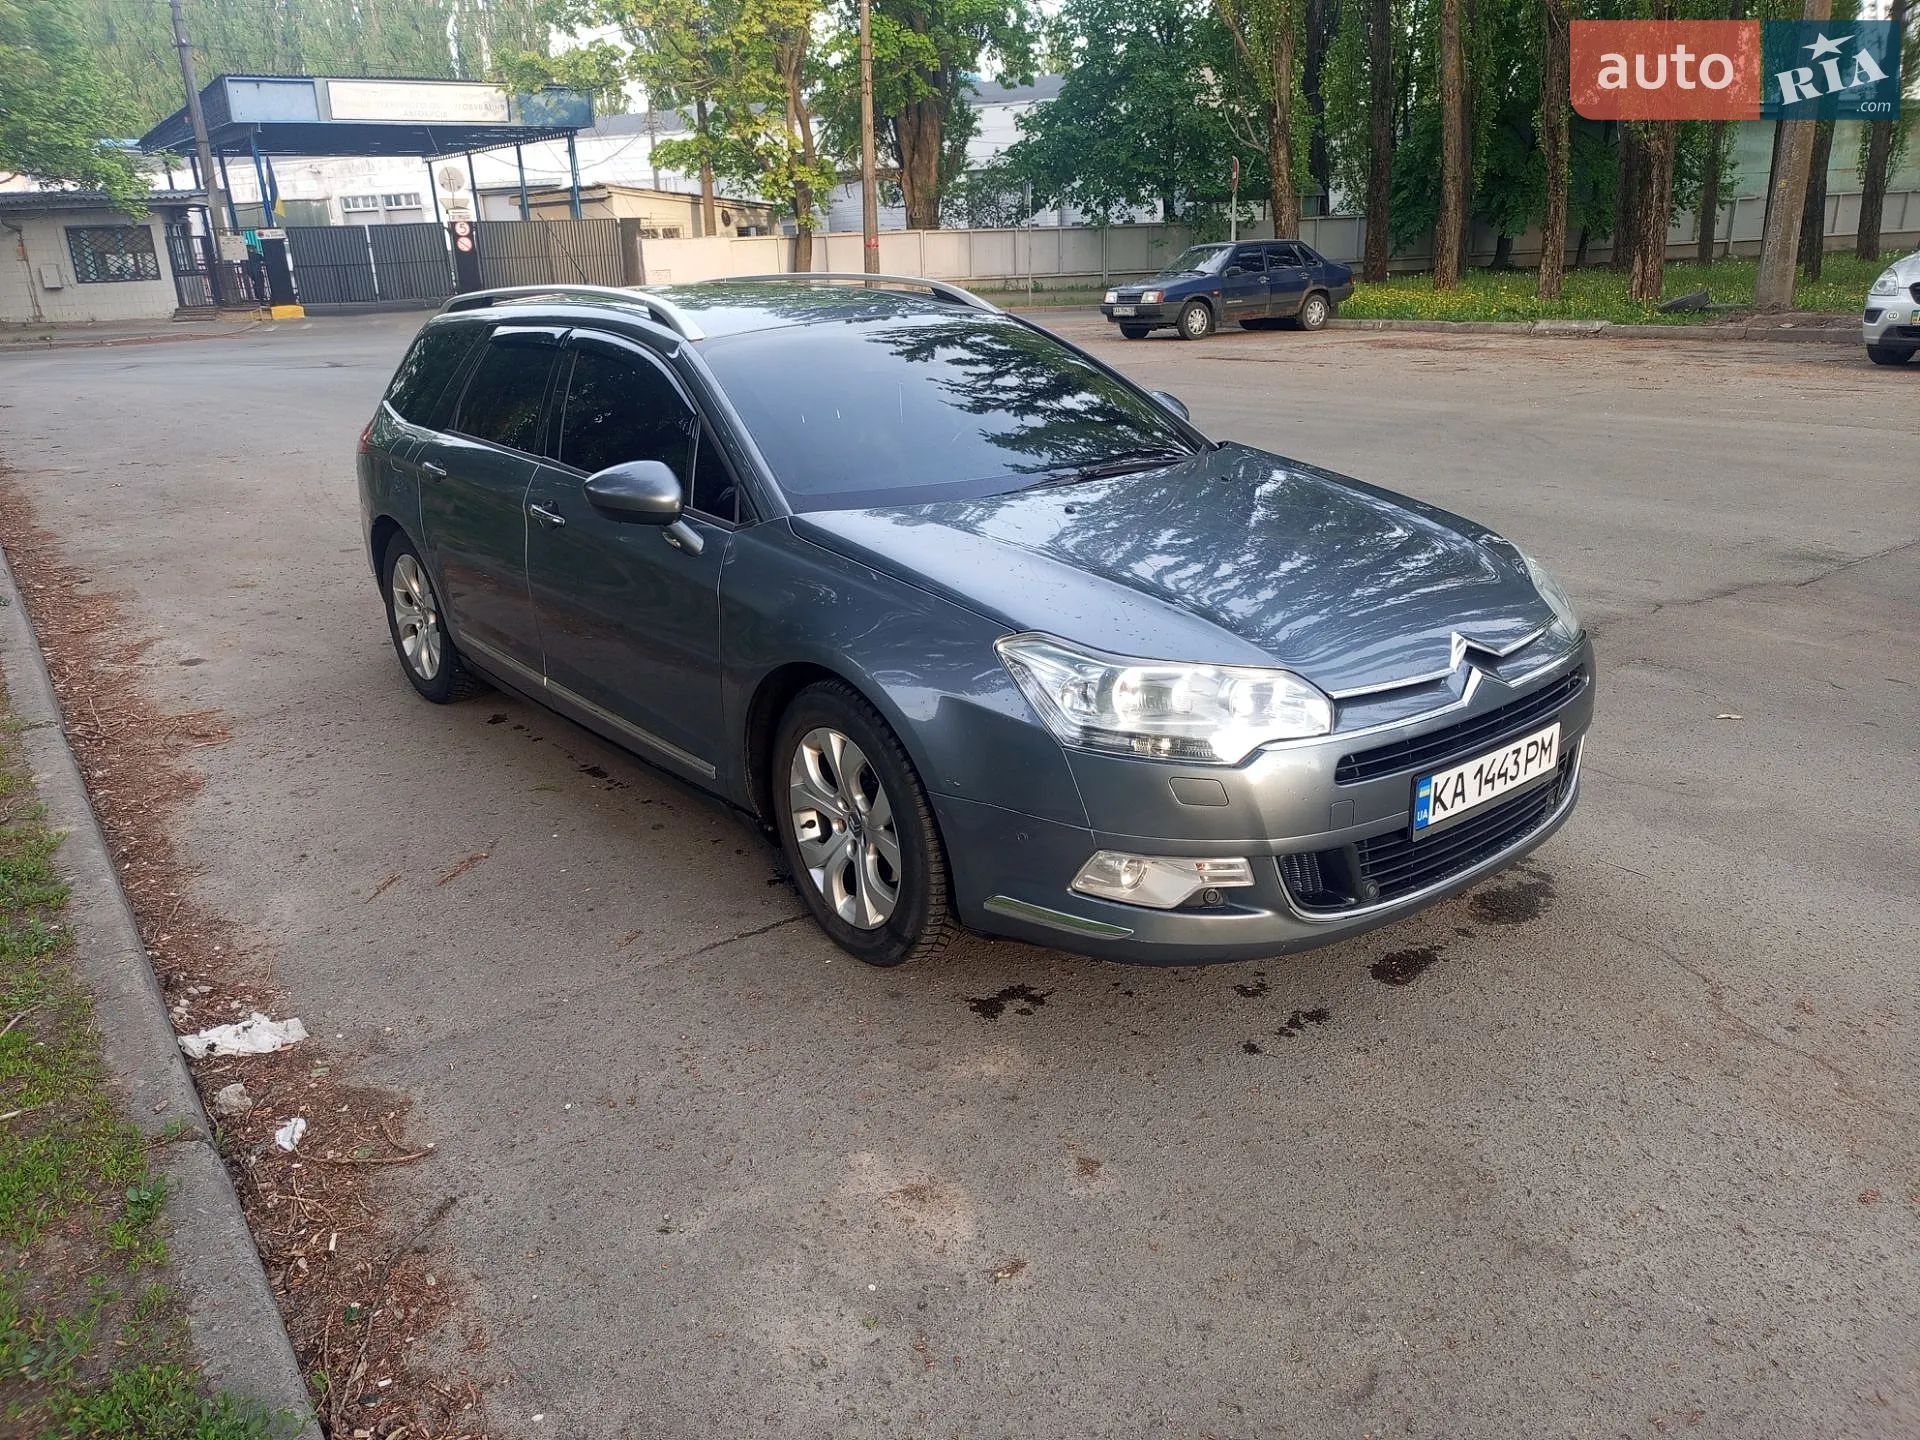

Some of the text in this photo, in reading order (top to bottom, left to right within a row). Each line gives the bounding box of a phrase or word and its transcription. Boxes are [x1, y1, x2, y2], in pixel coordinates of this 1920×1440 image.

[460, 223, 467, 234] 5
[1432, 733, 1553, 816] KA 1443 PM
[1417, 810, 1428, 821] UA
